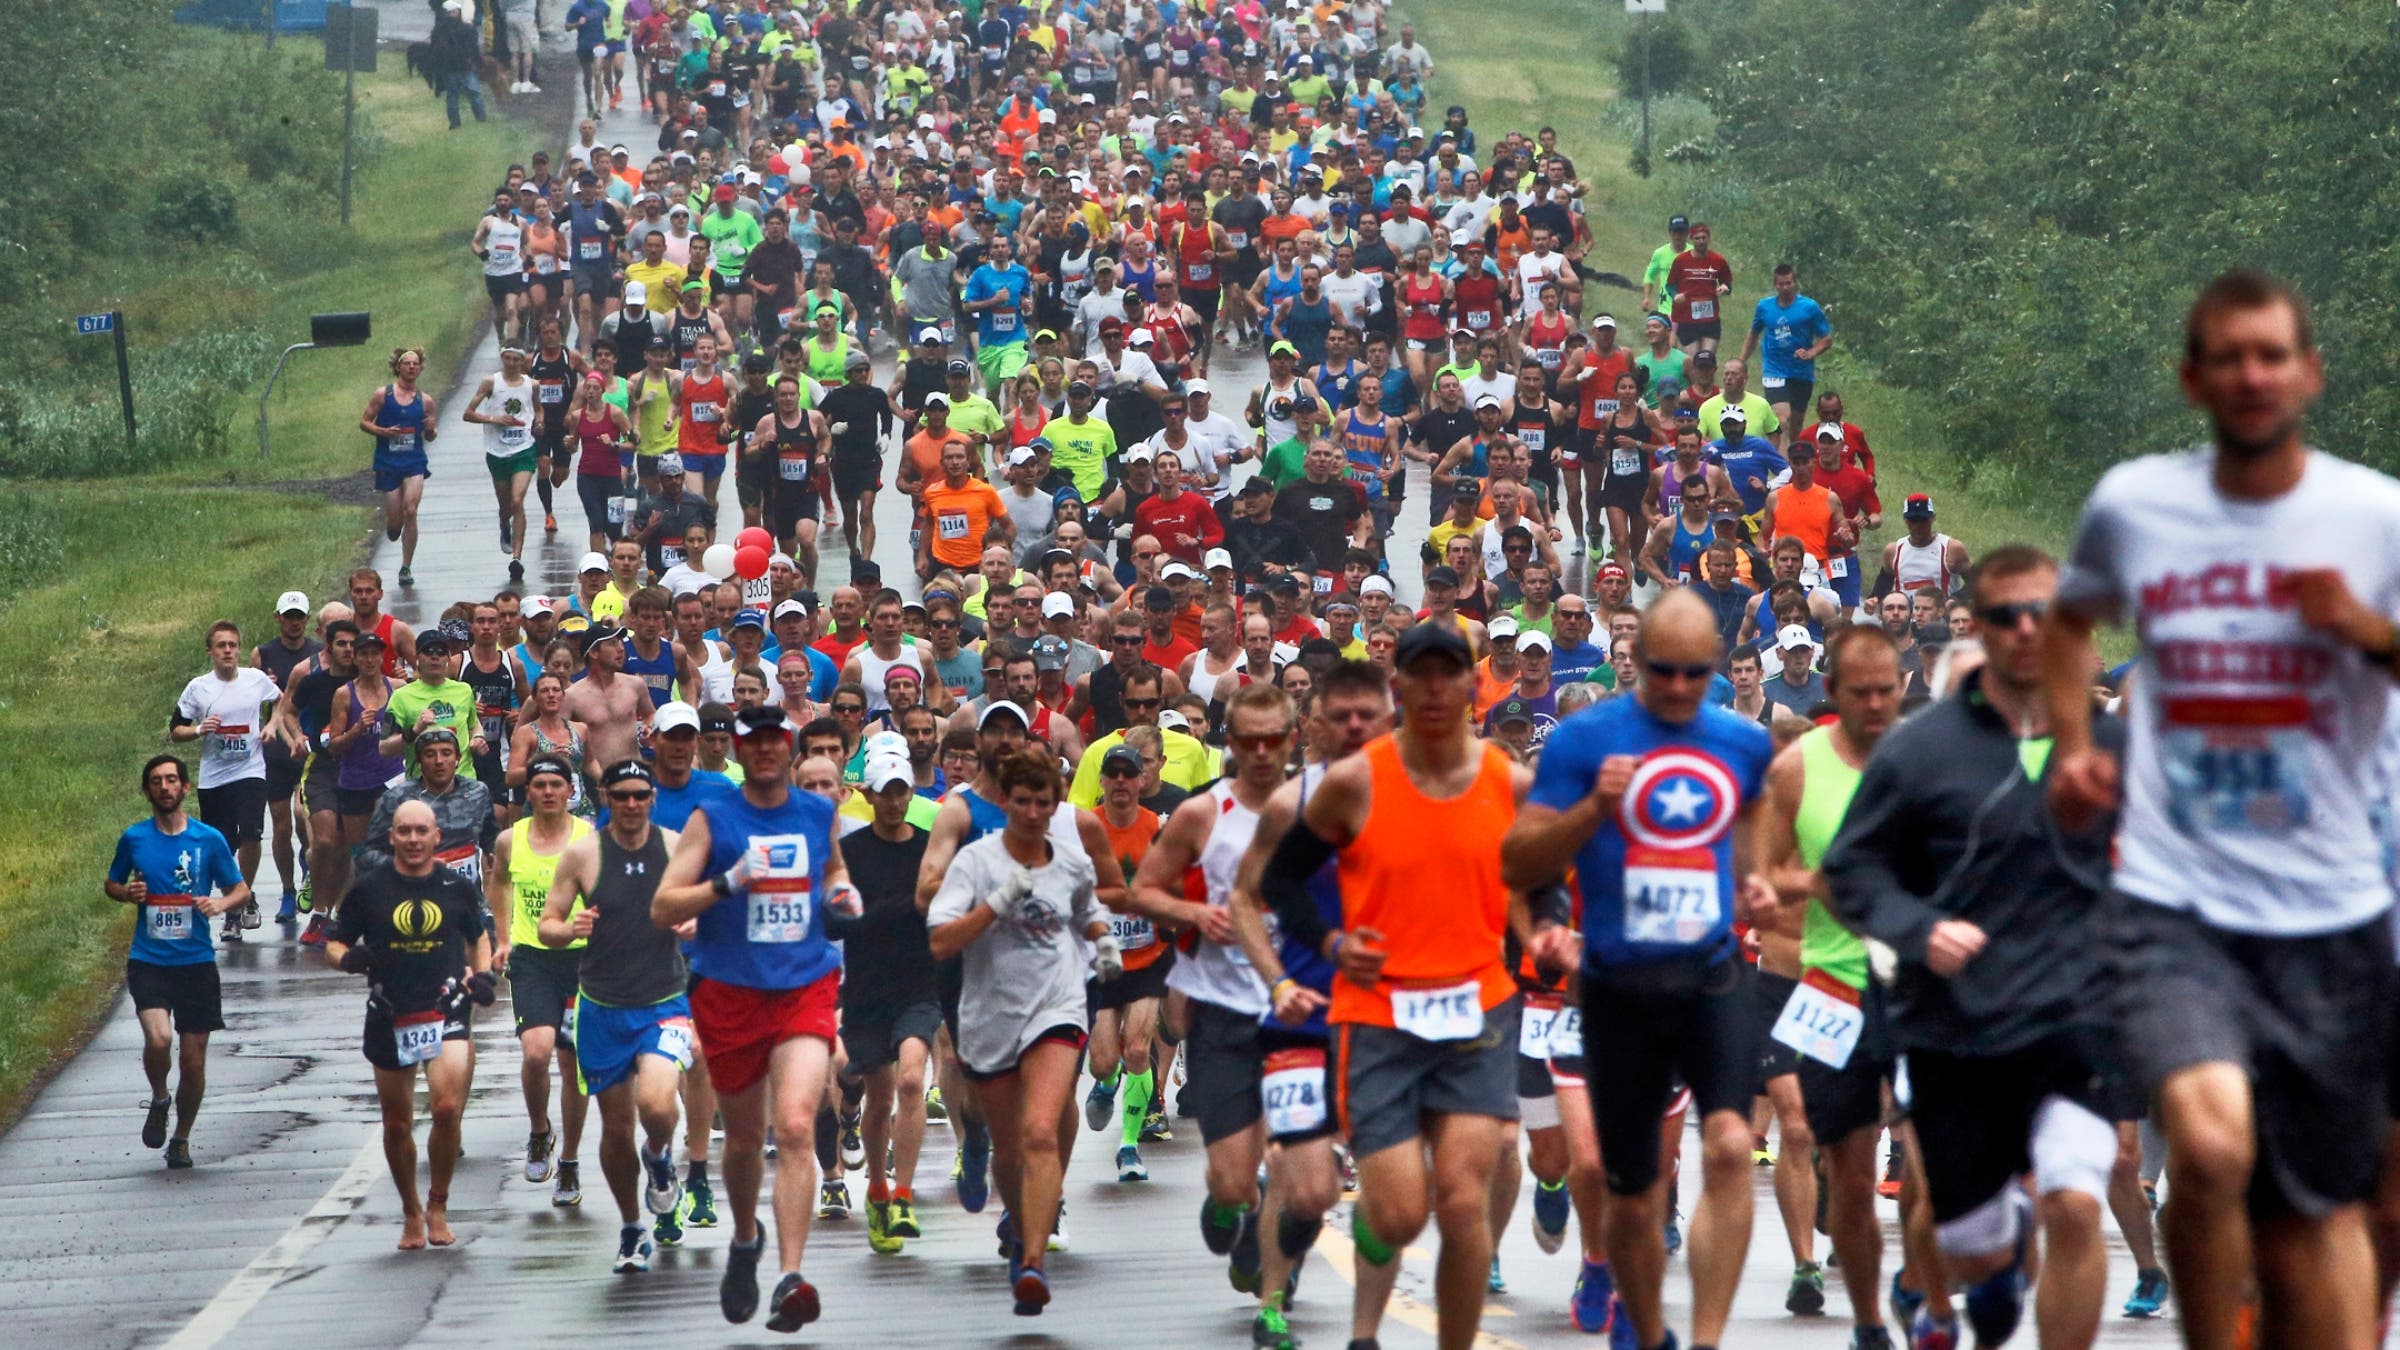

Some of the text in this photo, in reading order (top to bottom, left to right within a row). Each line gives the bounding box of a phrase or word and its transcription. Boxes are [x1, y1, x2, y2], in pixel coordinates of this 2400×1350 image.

[84, 315, 106, 331] 677
[680, 326, 706, 335] TEAM
[942, 519, 966, 531] 1114
[746, 577, 770, 598] 3:05
[155, 912, 183, 928] 885
[756, 902, 804, 926] 1533
[1793, 1001, 1852, 1041] 1127
[402, 1028, 438, 1049] 4343
